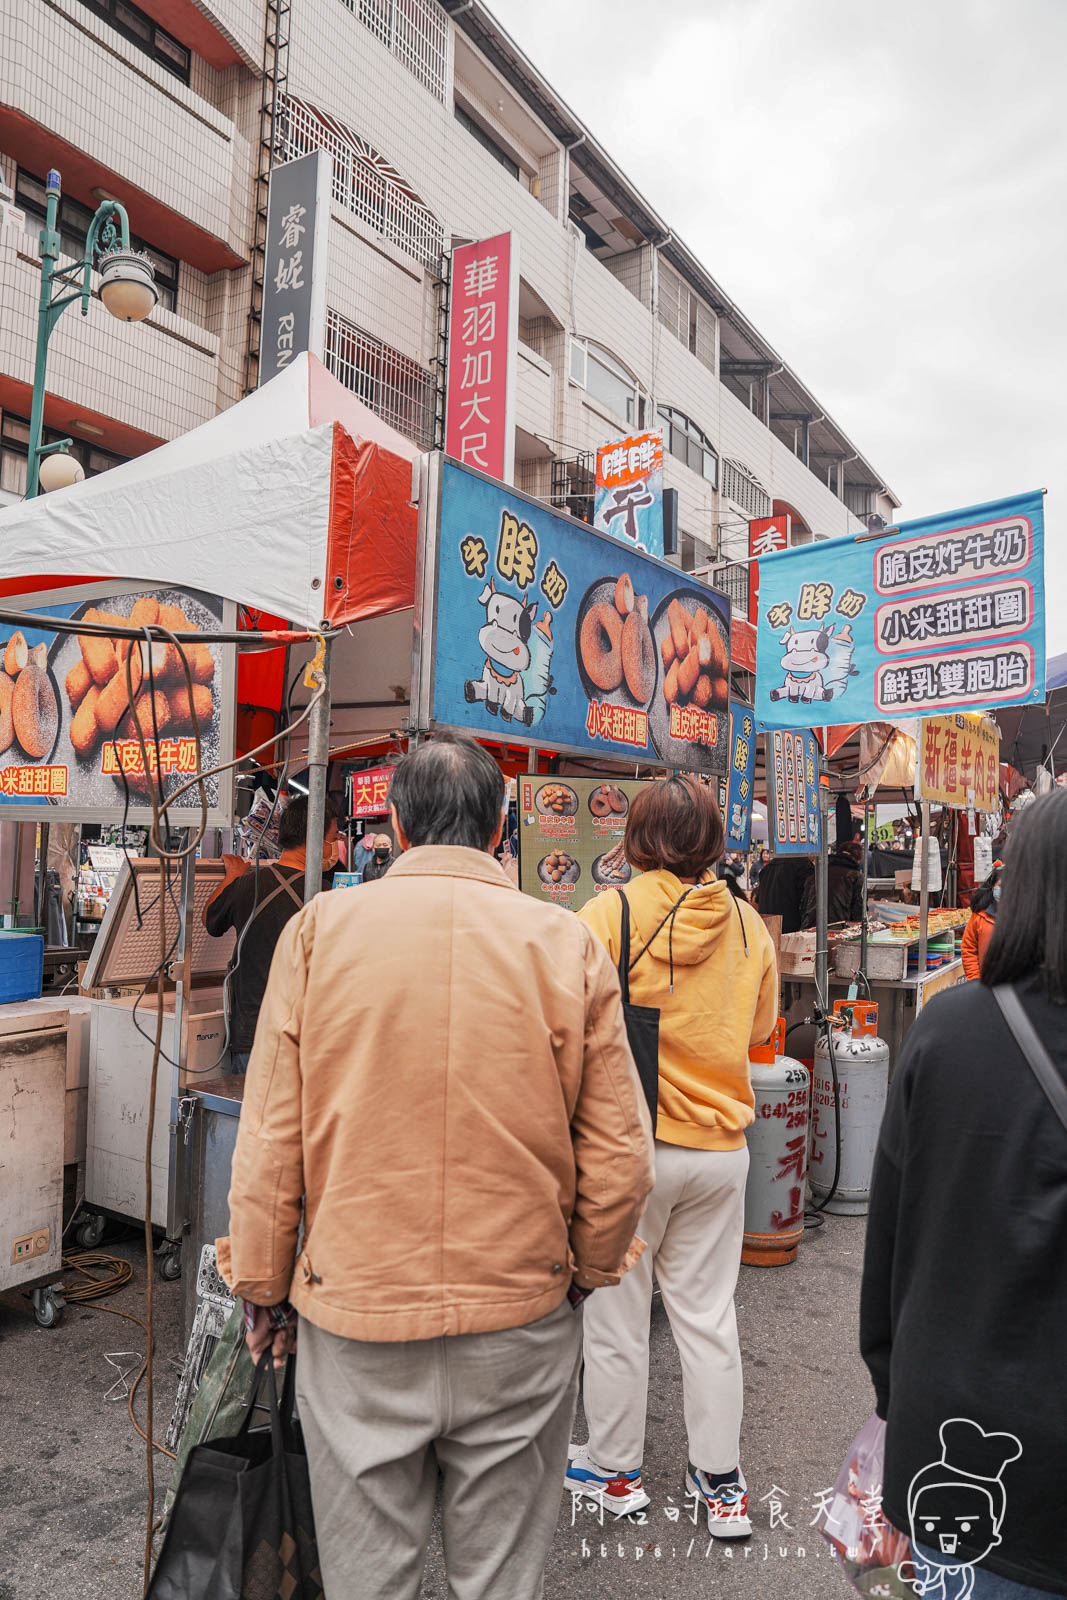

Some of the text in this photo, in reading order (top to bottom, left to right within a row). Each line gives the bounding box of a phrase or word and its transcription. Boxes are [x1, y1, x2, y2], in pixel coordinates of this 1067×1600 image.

[274, 203, 307, 294] 睿妮
[460, 255, 499, 467] 華羽加大尺
[881, 526, 1024, 587] 脆皮炸牛奶
[882, 588, 1024, 645] 小米甜甜圈
[882, 653, 1027, 703] 鮮乳雙胞胎
[587, 701, 647, 746] 小米甜甜圈
[671, 706, 717, 746] 脆皮炸牛奶
[102, 741, 198, 772] 脆皮炸牛奶
[925, 720, 996, 803] 新疆羊肉串
